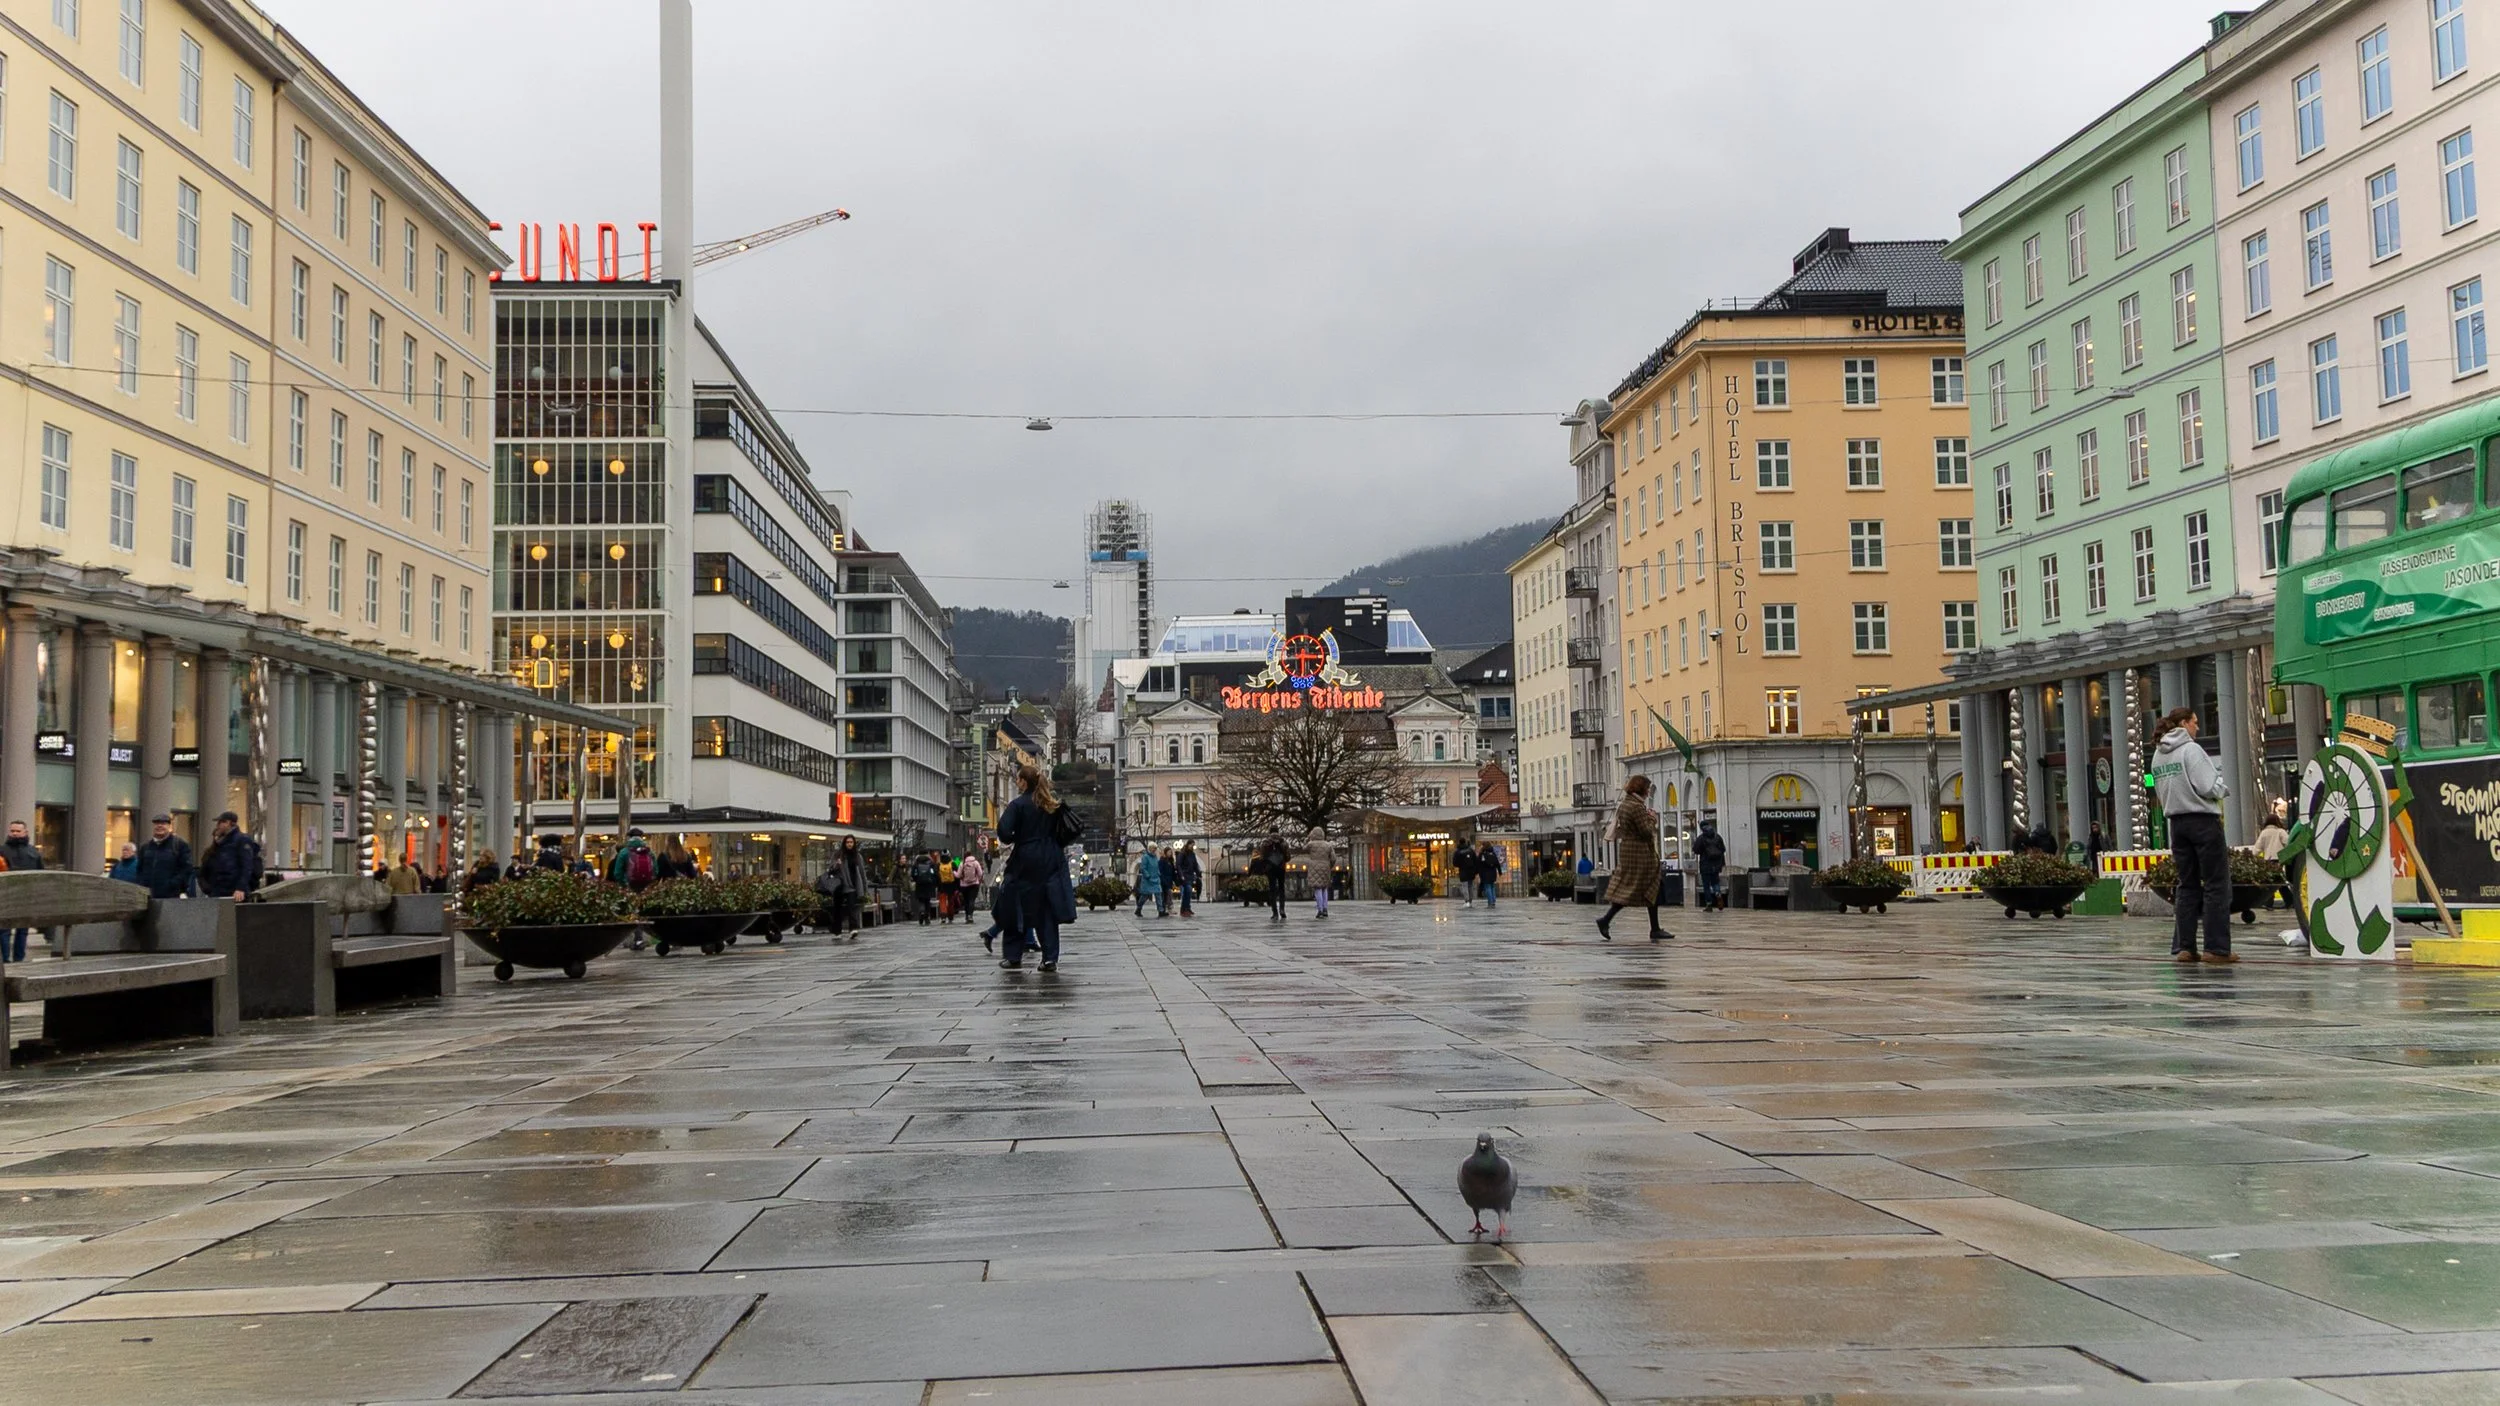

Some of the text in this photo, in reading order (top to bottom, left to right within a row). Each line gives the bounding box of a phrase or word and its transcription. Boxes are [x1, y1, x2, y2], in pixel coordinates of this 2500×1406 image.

[1864, 313, 1965, 332] HOTEL B
[1724, 376, 1749, 654] HOTEL BRISTOL
[2380, 545, 2456, 577] VASSENDGUTANE
[2316, 592, 2365, 617] DONKEYBOY
[1221, 685, 1384, 714] Bergens Tidende
[1760, 810, 1817, 818] McDonald's
